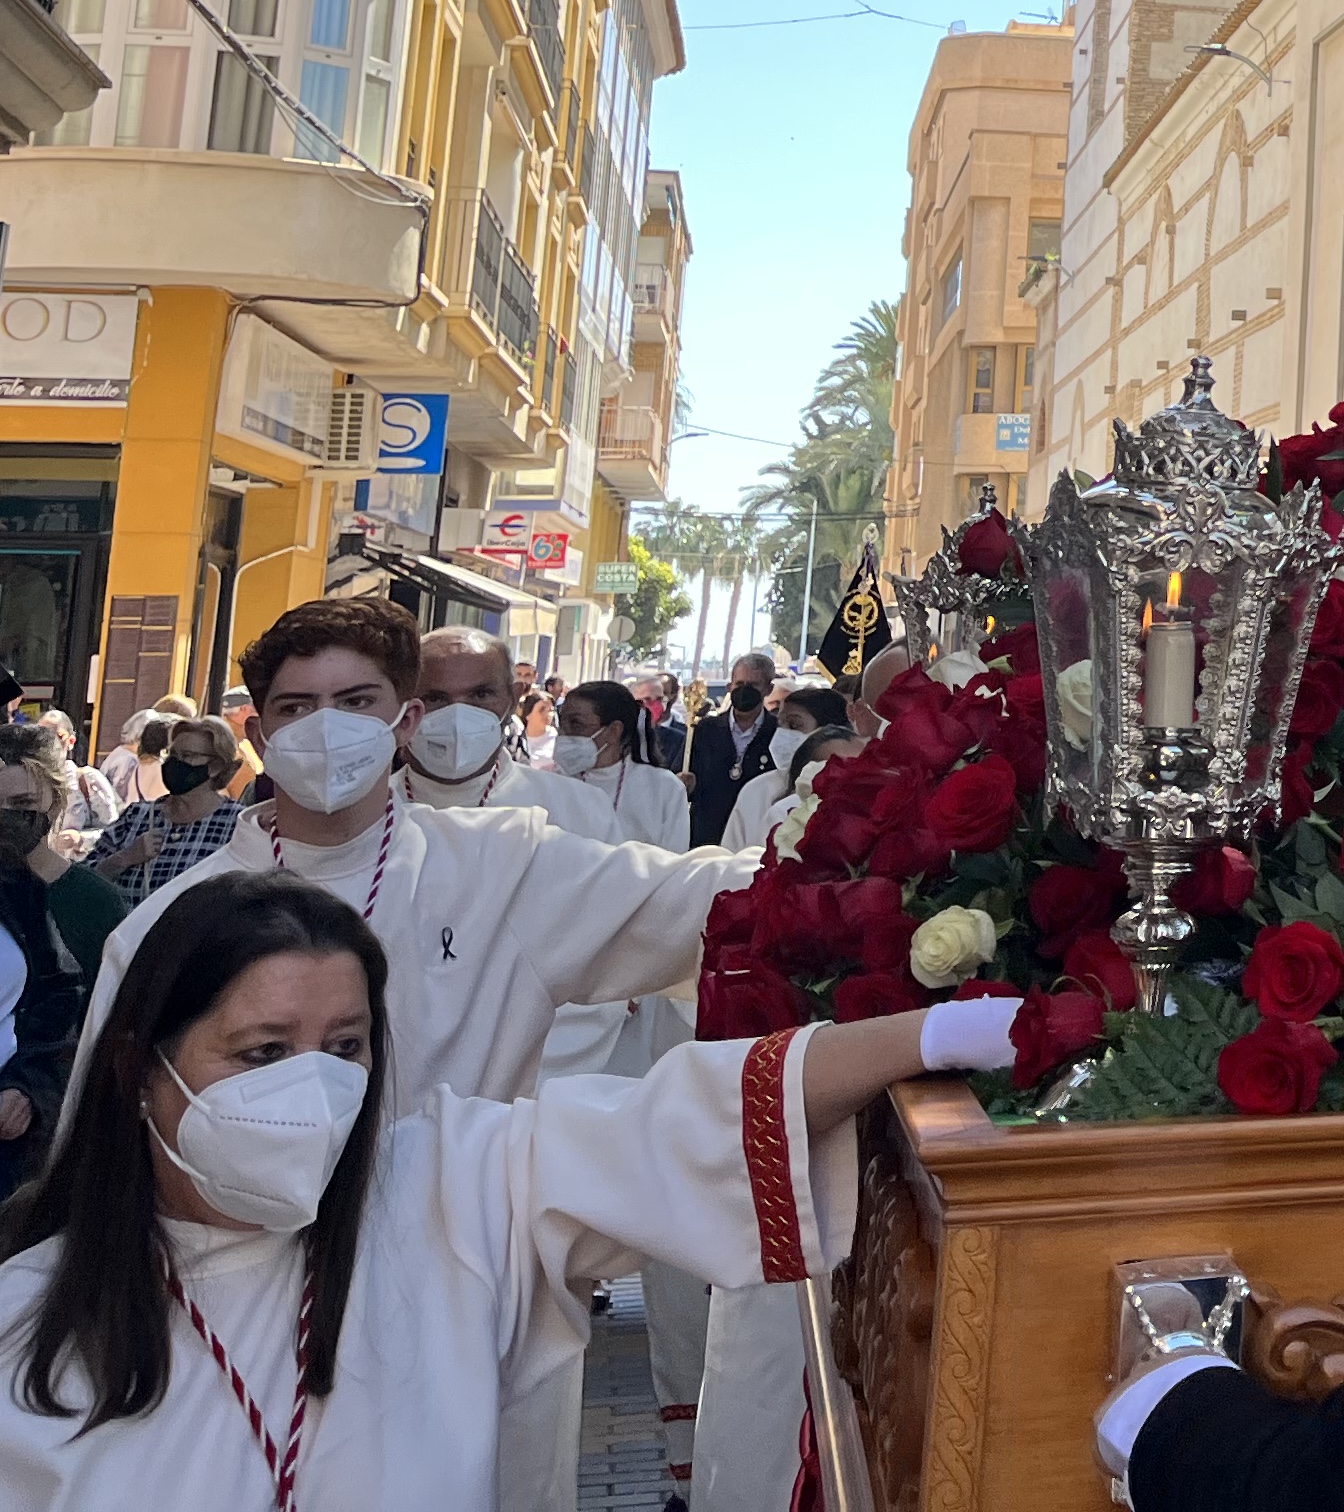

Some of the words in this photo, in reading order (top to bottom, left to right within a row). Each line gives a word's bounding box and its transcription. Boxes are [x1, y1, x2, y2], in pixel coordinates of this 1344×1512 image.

[30, 386, 43, 397] a
[49, 378, 121, 398] domicilio
[598, 564, 637, 573] SUPER
